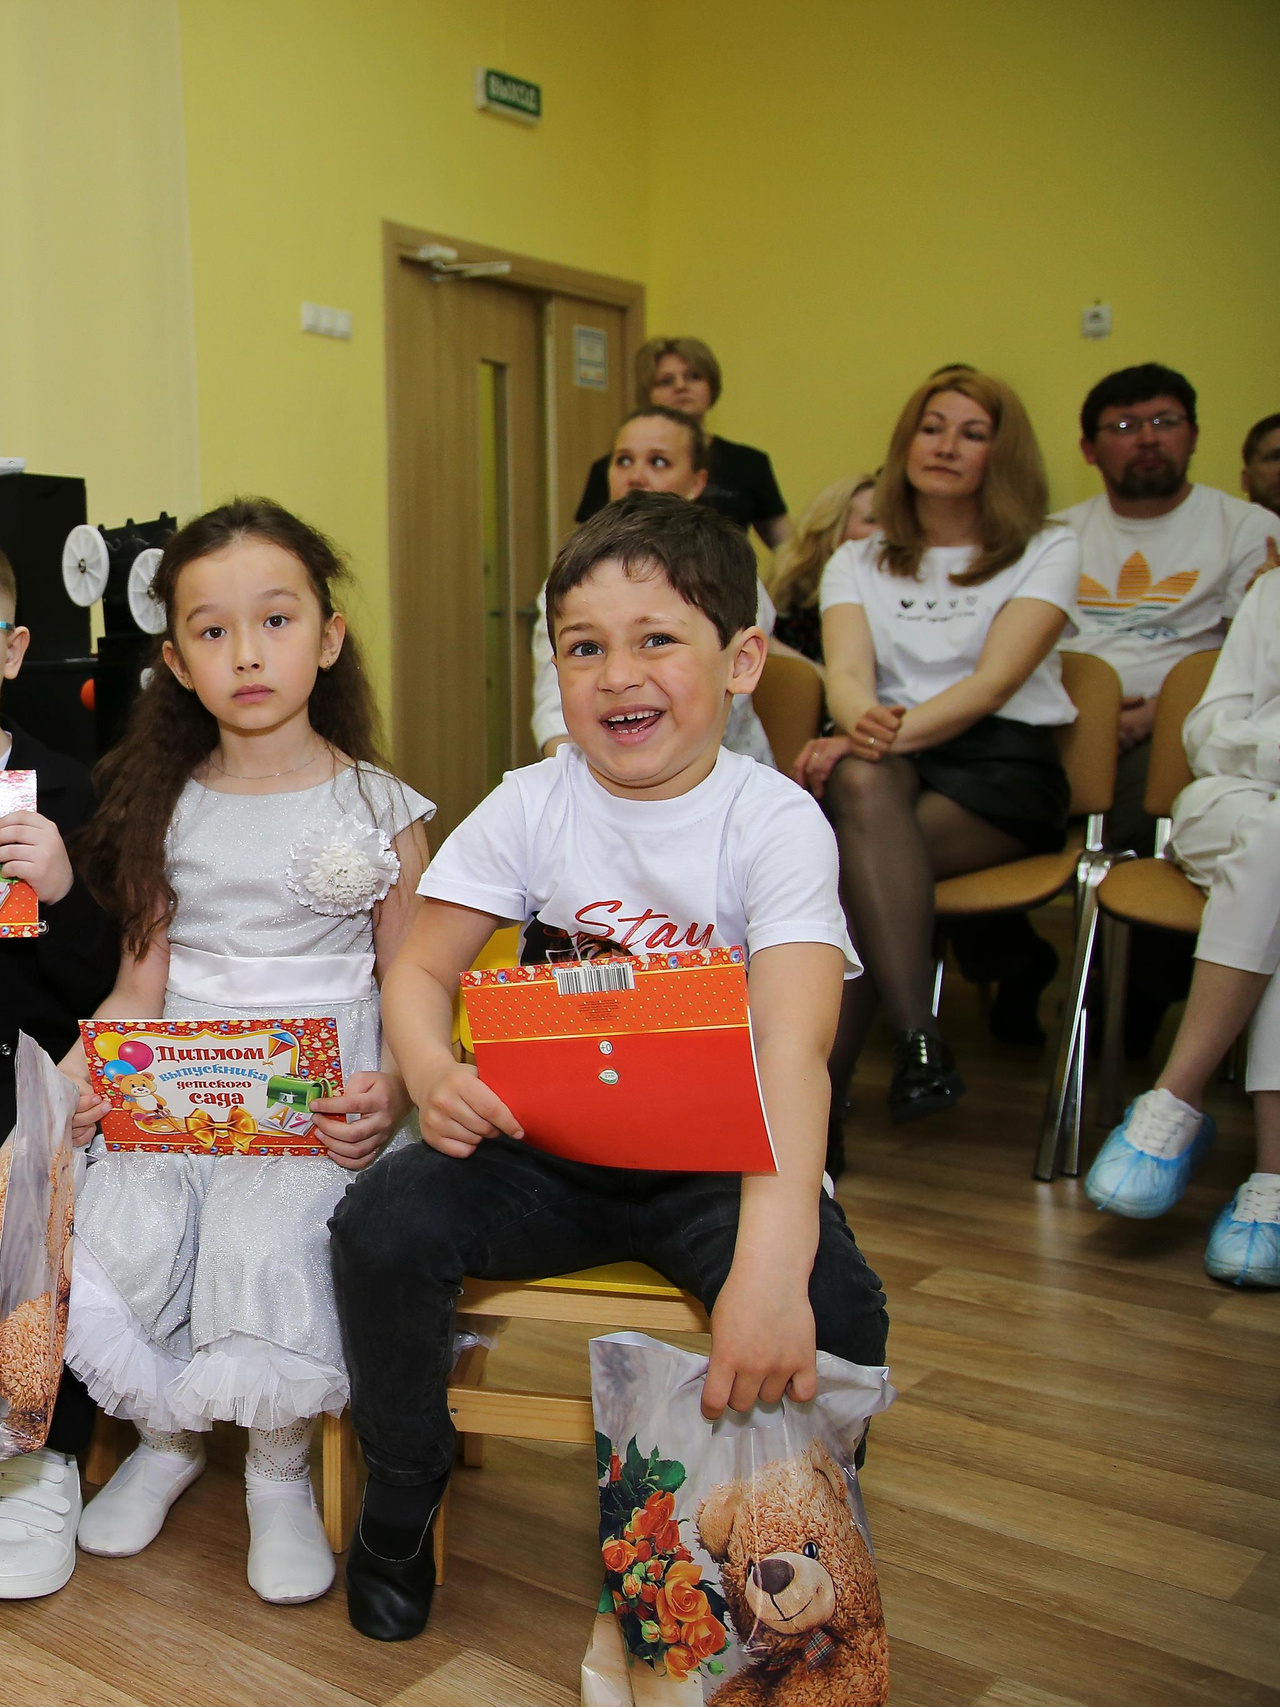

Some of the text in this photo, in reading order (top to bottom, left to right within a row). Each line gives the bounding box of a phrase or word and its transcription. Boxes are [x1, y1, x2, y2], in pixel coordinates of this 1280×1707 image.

[574, 899, 716, 950] Stay
[154, 1045, 265, 1064] Диплом
[158, 1064, 269, 1083] выпускника
[176, 1079, 252, 1090] детского
[189, 1091, 245, 1108] сада
